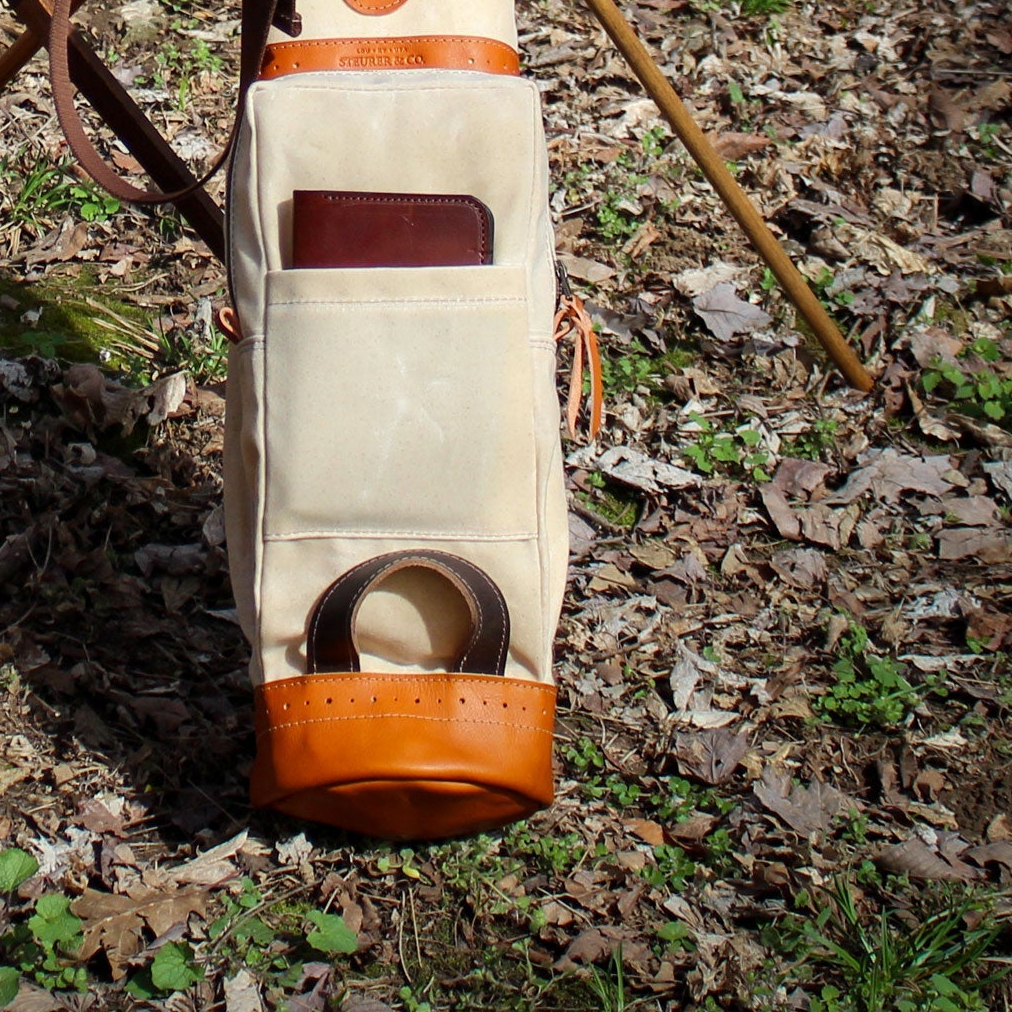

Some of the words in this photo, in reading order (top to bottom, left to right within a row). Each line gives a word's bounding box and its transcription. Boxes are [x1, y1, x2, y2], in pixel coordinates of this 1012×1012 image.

[338, 55, 392, 68] STEURER
[394, 55, 405, 66] &
[406, 54, 426, 65] CO.
